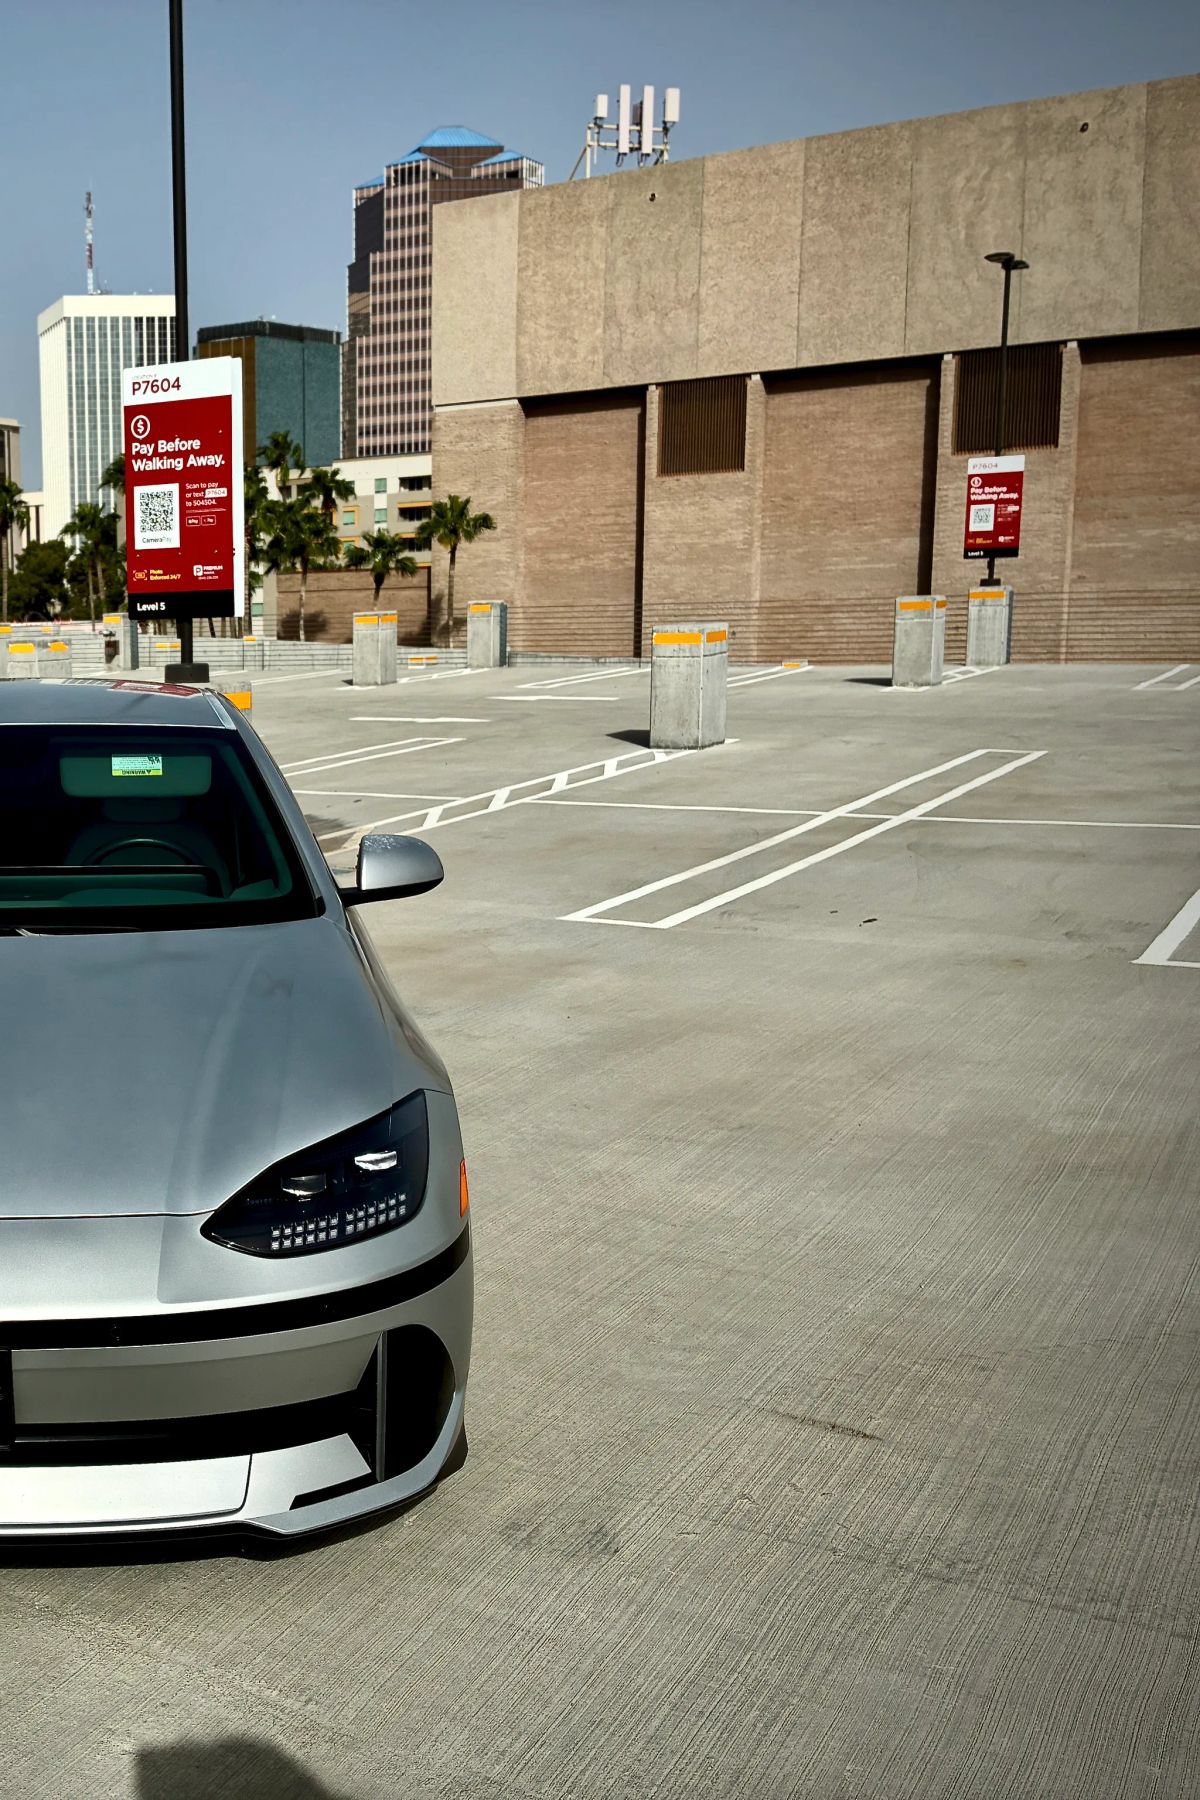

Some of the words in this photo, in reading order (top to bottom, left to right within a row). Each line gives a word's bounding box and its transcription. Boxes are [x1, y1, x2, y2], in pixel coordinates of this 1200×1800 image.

[132, 376, 181, 396] P7604
[131, 442, 155, 456] Pay
[157, 438, 201, 453] Before
[132, 456, 184, 472] Walking
[186, 454, 225, 468] Away.
[137, 602, 158, 611] Level
[160, 602, 166, 610] 5
